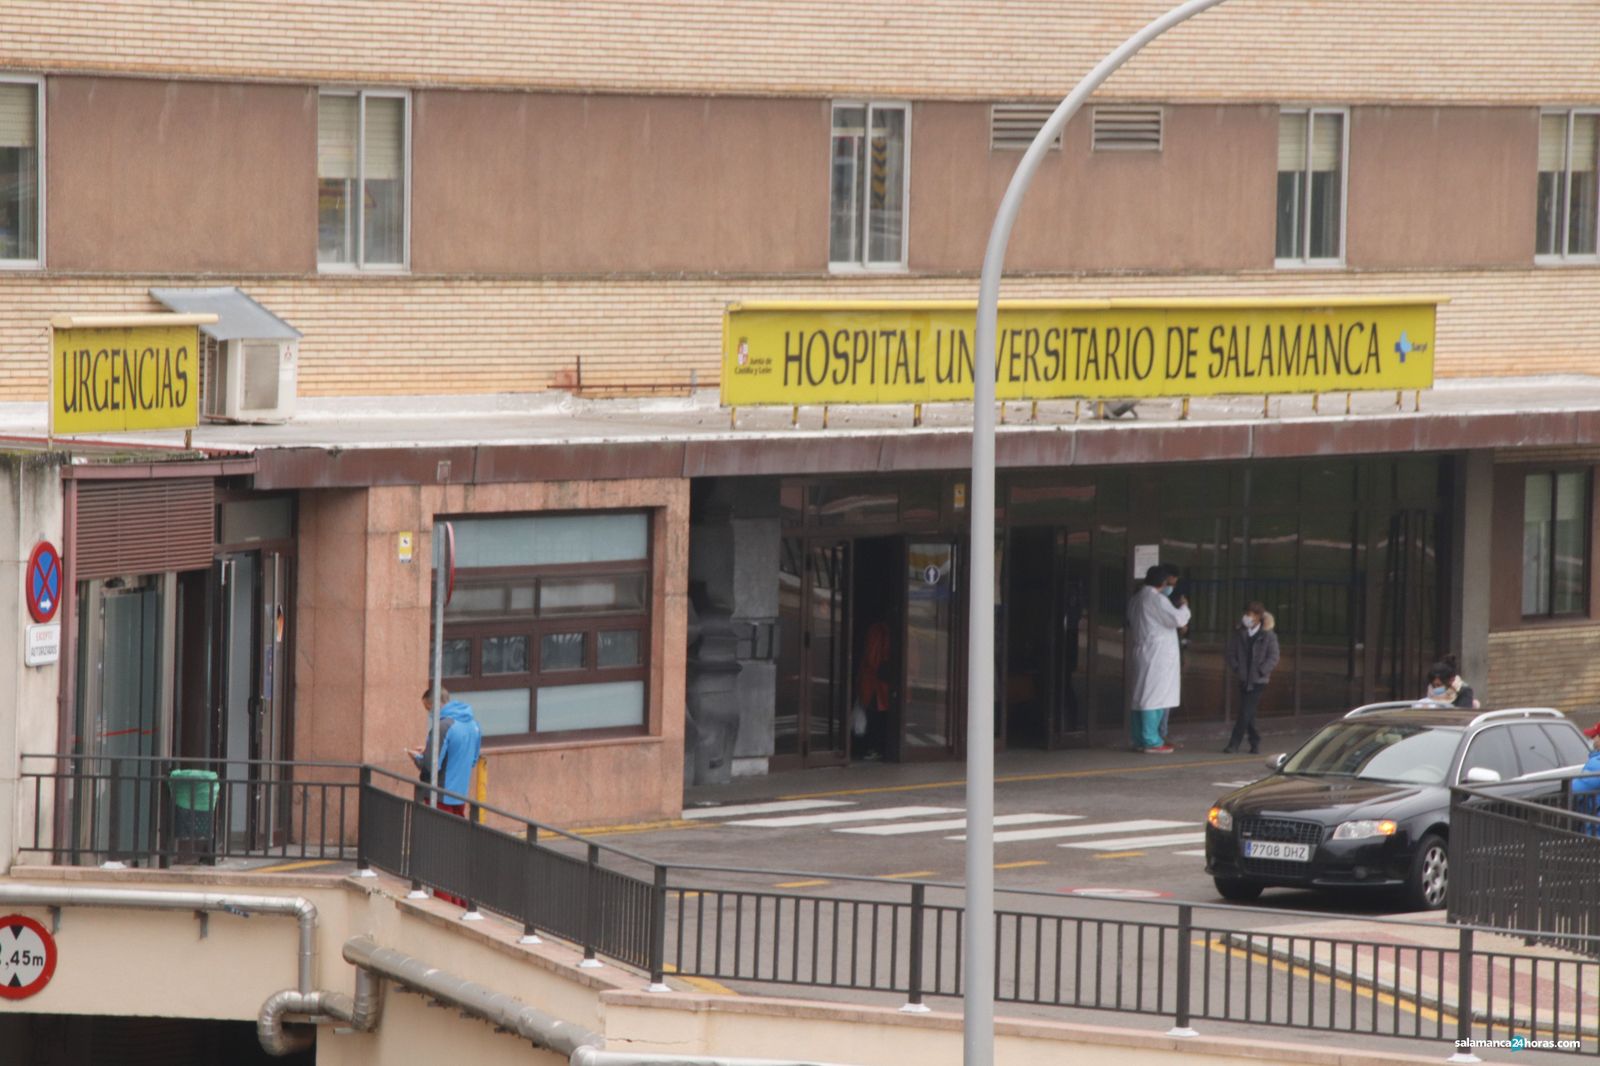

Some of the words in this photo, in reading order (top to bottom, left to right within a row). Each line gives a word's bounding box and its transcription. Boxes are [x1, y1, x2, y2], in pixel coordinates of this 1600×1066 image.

[62, 346, 188, 413] URGENCIAS
[783, 329, 926, 387] HOSPITAL
[934, 325, 1155, 384] UNVERSITARIO
[1165, 326, 1199, 379] DE
[1208, 322, 1381, 378] SALAMANCA
[1252, 844, 1280, 856] 7708
[1283, 846, 1306, 859] DHZ
